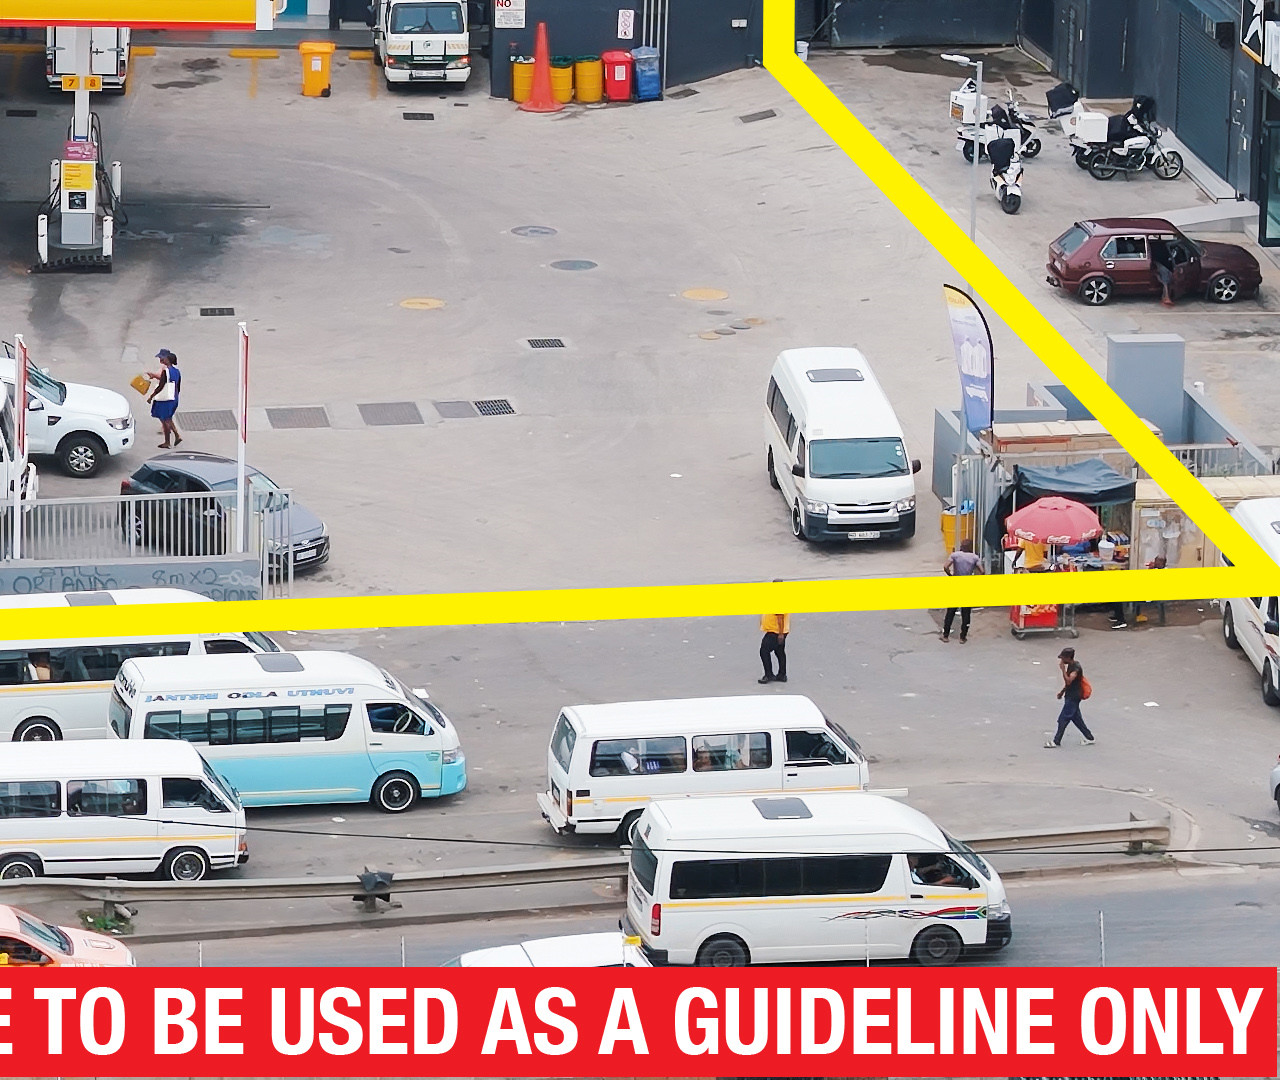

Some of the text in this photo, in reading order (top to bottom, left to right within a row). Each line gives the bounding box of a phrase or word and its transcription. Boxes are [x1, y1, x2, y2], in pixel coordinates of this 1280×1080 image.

[496, 0, 512, 8] NO
[68, 78, 75, 87] 7
[89, 79, 95, 87] 8
